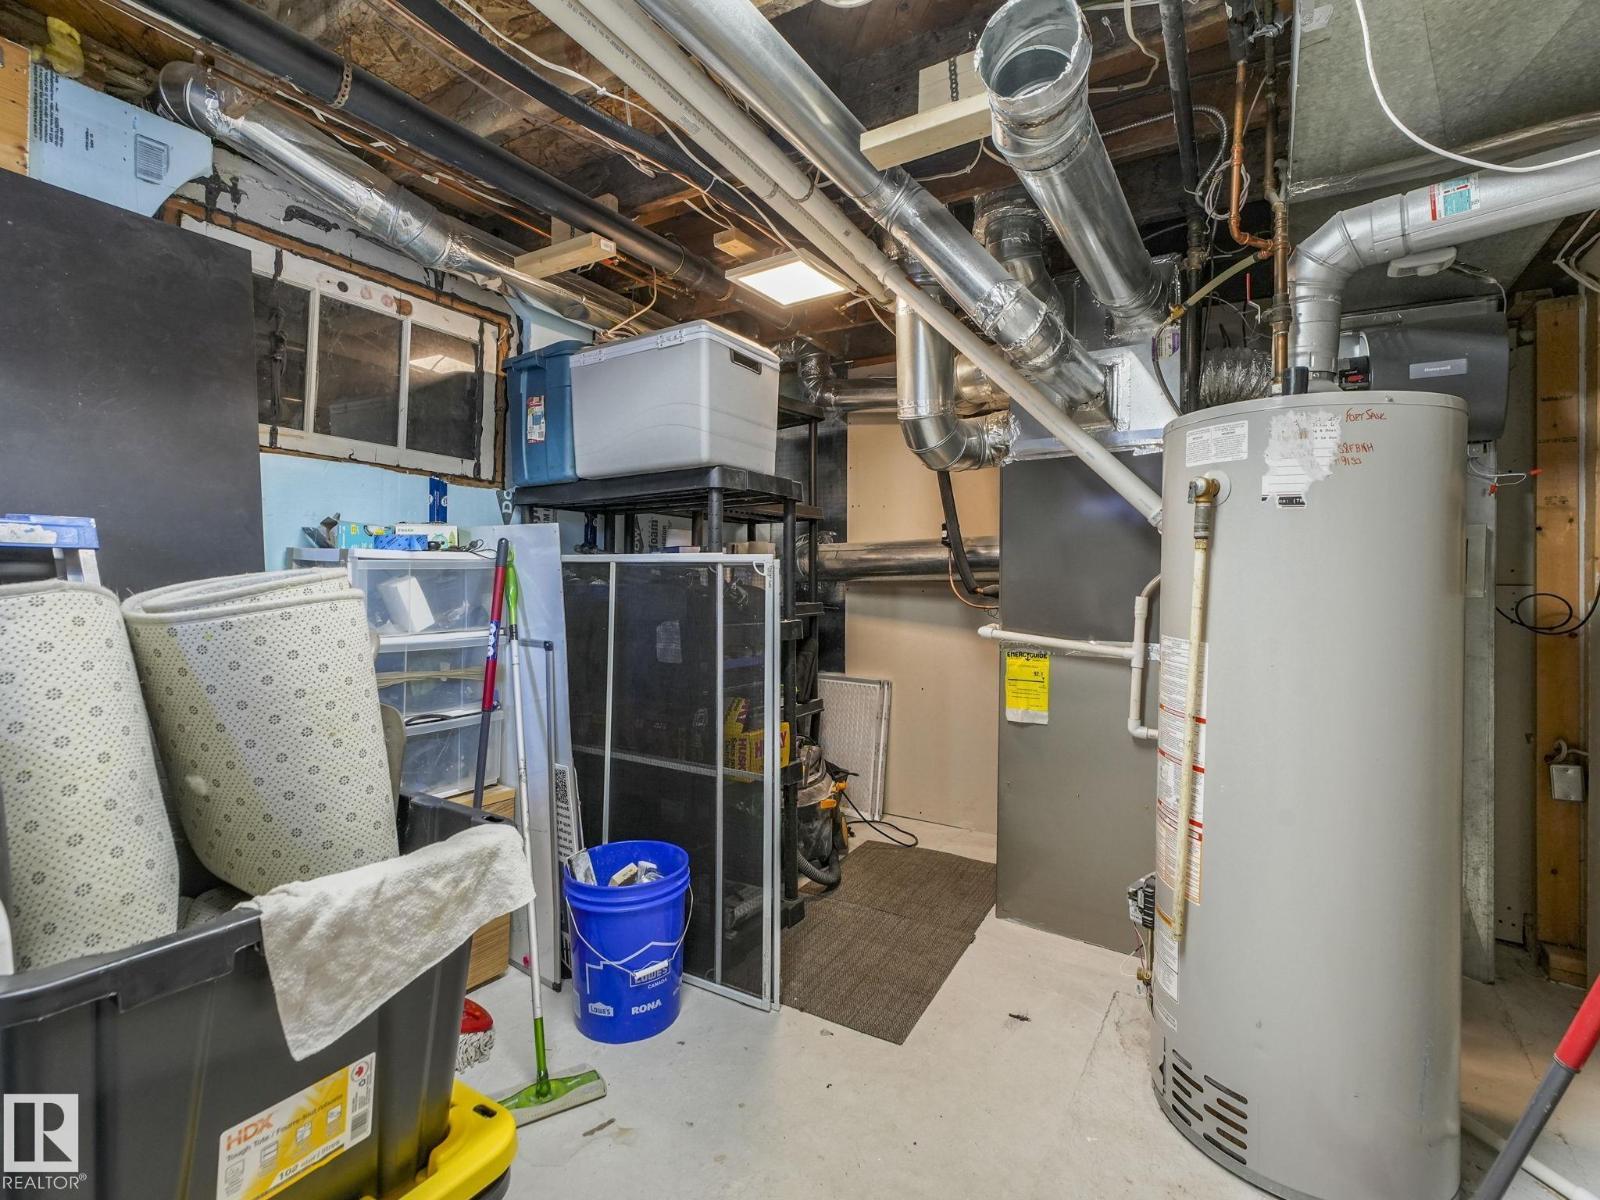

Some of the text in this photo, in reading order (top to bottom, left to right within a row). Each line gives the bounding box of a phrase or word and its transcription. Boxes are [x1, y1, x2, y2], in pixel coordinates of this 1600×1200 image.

[647, 977, 668, 990] CANADA
[631, 998, 662, 1016] RONA
[225, 1113, 274, 1152] HDX
